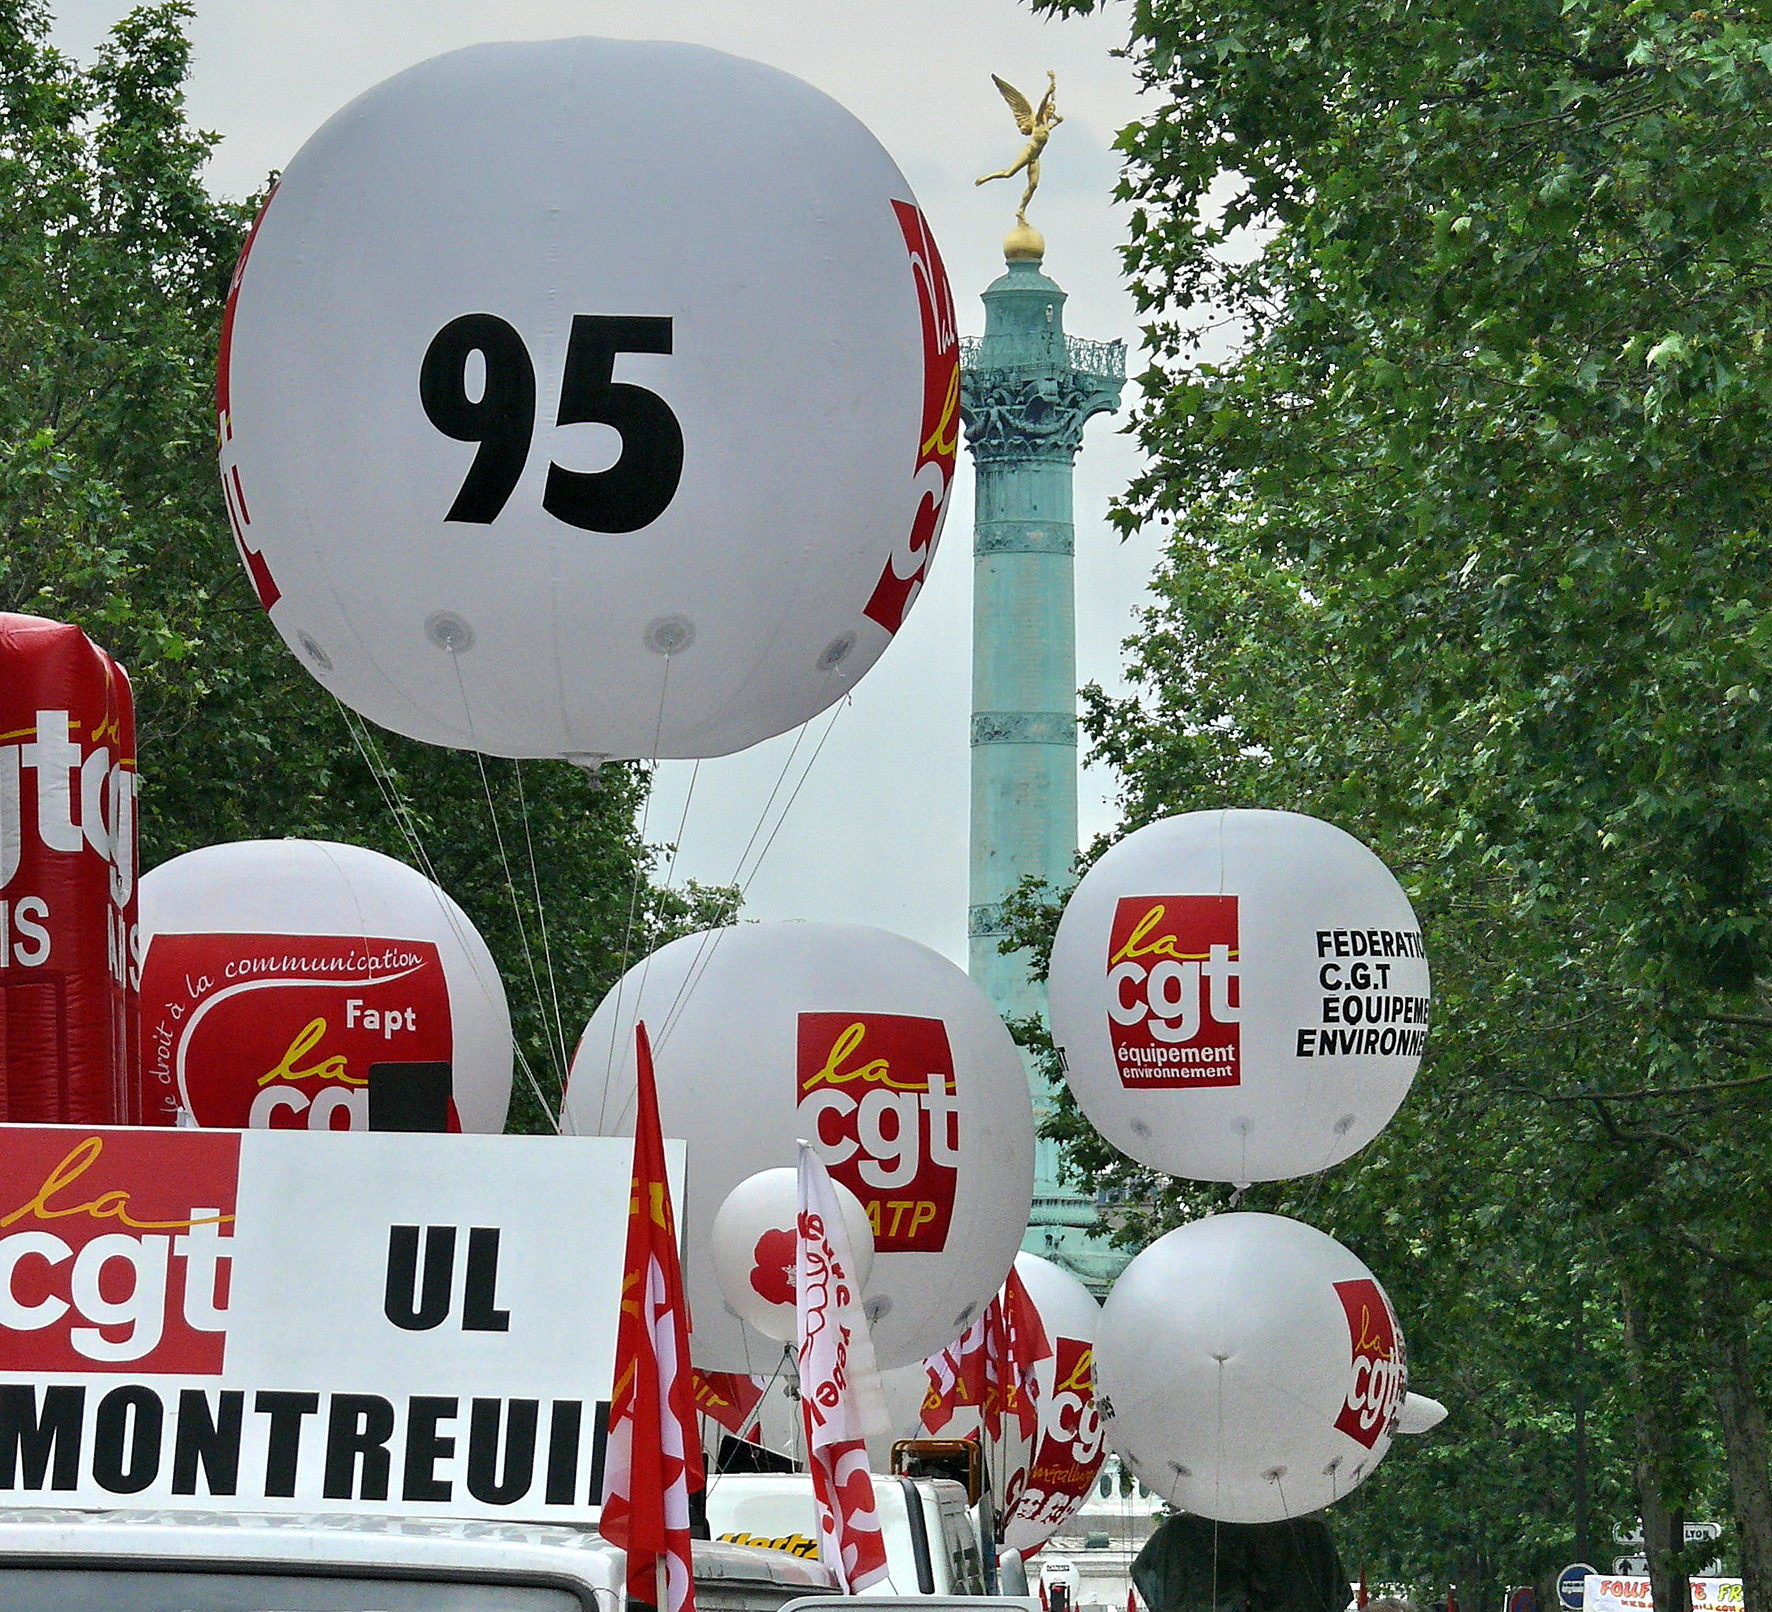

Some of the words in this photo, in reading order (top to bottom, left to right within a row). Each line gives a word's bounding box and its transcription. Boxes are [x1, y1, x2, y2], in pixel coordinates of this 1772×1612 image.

[419, 311, 685, 534] 95
[1110, 904, 1239, 965] la
[1106, 943, 1241, 1043] cgt
[1319, 962, 1391, 991] C.G.T
[149, 1021, 174, 1085] droit
[185, 973, 215, 999] la
[225, 948, 423, 978] communication
[345, 999, 417, 1040] Fapt
[257, 1017, 369, 1086] la
[802, 1022, 956, 1090] la
[1118, 1041, 1236, 1067] équipement
[1122, 1064, 1233, 1080] environnement
[796, 1073, 959, 1189] cgt
[0, 1136, 236, 1229] la
[866, 1200, 937, 1238] ATP
[0, 1207, 234, 1363] cgt
[383, 1225, 511, 1333] UL
